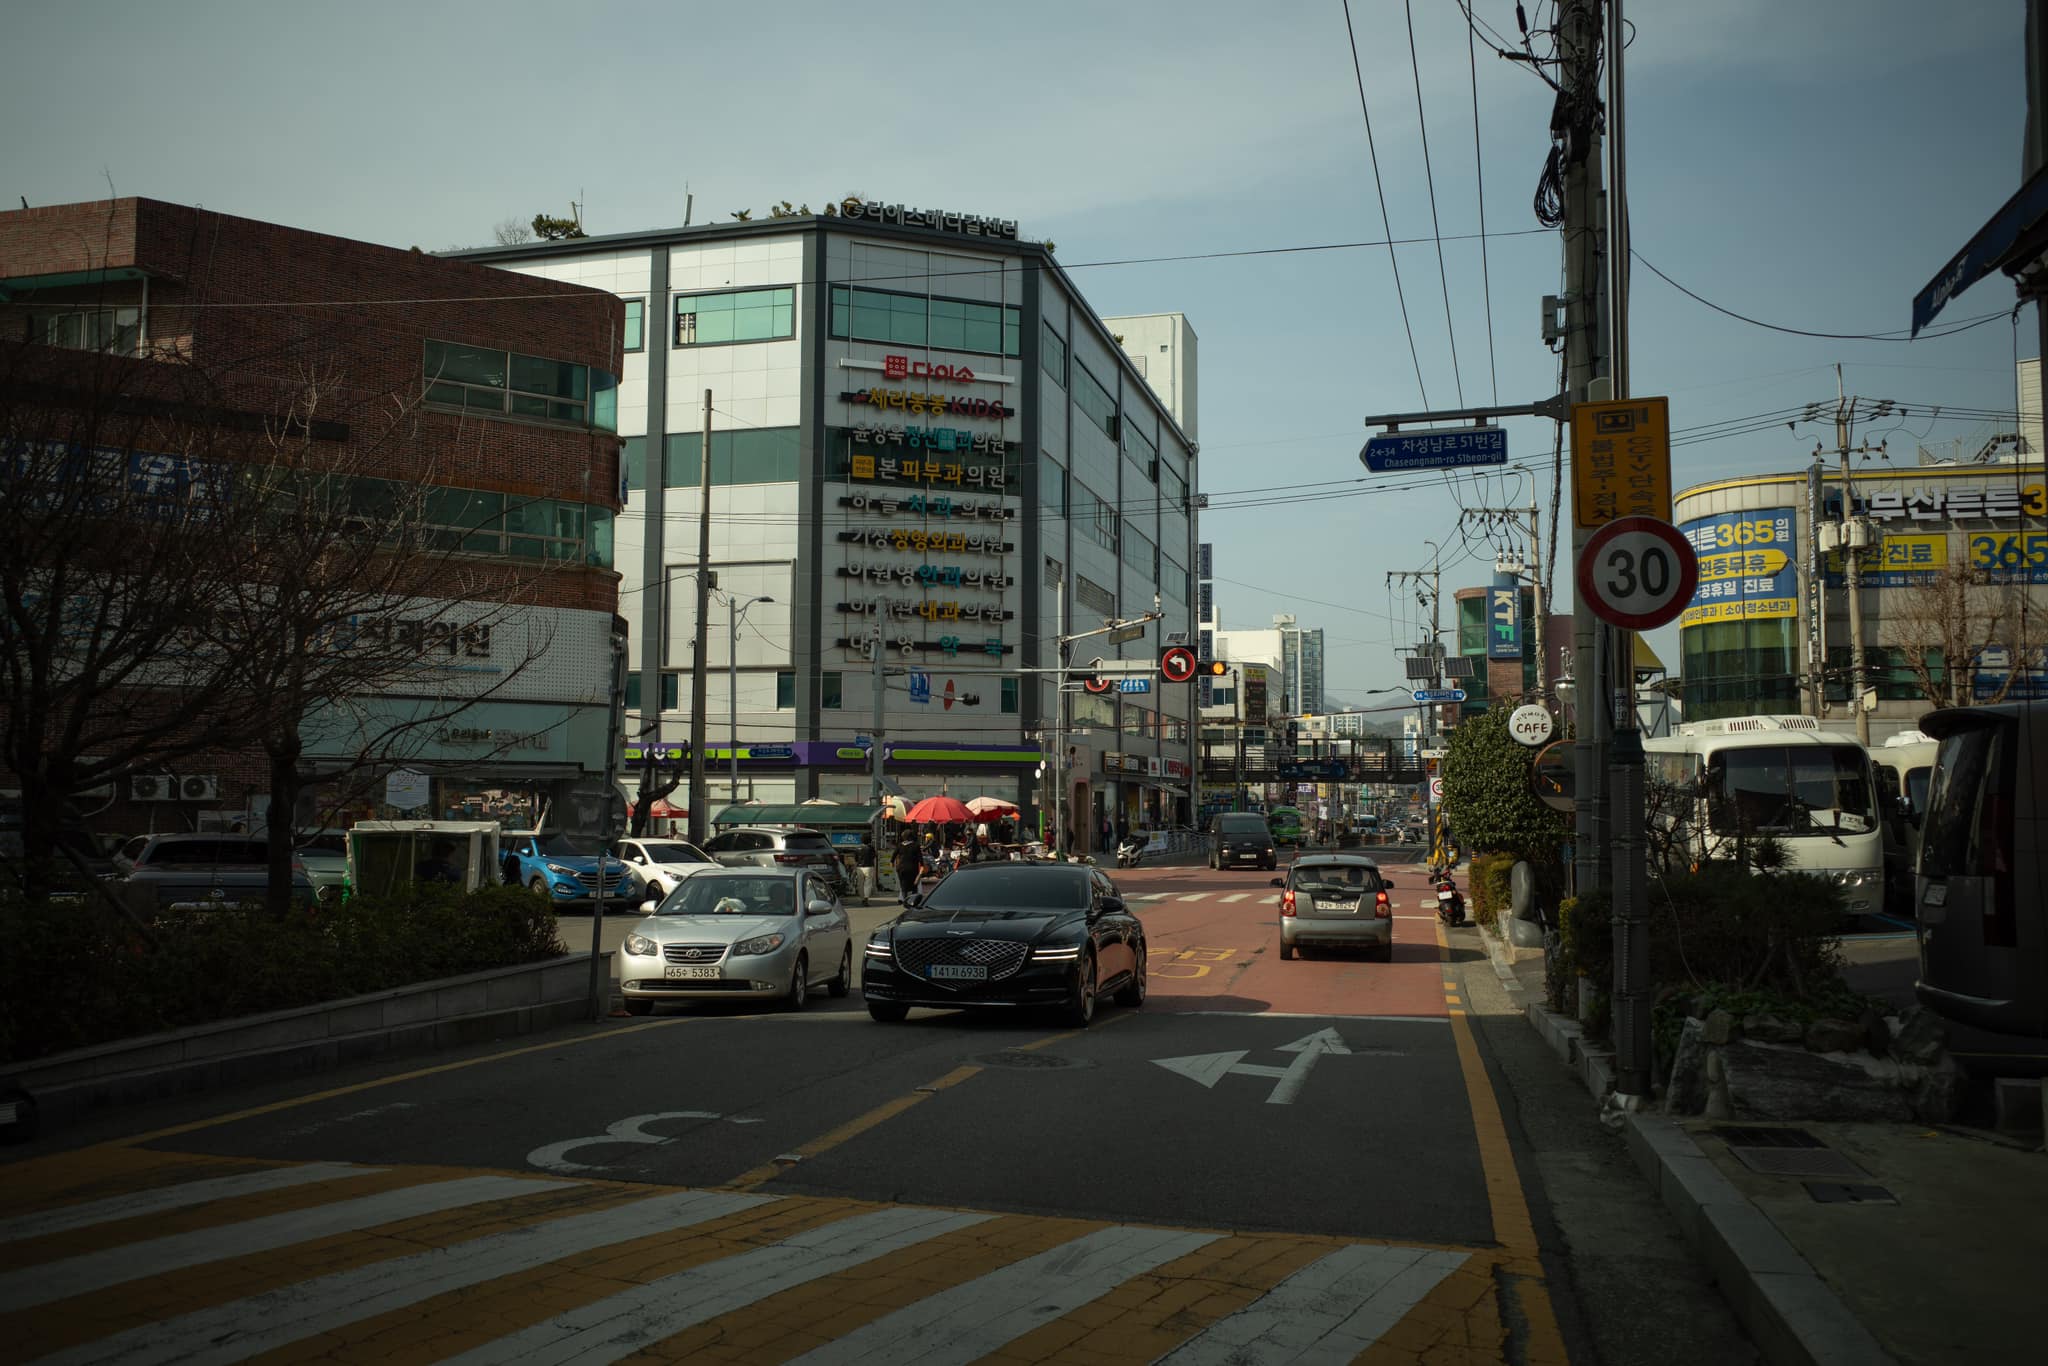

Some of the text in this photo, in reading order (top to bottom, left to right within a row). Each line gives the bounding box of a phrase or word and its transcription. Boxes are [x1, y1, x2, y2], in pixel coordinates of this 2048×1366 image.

[913, 362, 976, 383] 다이소
[868, 387, 1005, 418] 체리봉봉 KIDS
[1402, 432, 1502, 454] 차성남로 51번길
[1384, 451, 1501, 468] Chaseongnam-ro 51beon-gil
[1607, 547, 1670, 598] 30
[1700, 554, 1766, 577] 연중무휴
[1744, 578, 1775, 594] 진료
[1494, 590, 1514, 641] KTF
[1725, 601, 1790, 617] 소아청소년과
[1516, 722, 1549, 734] CAFE
[692, 968, 715, 977] 5383
